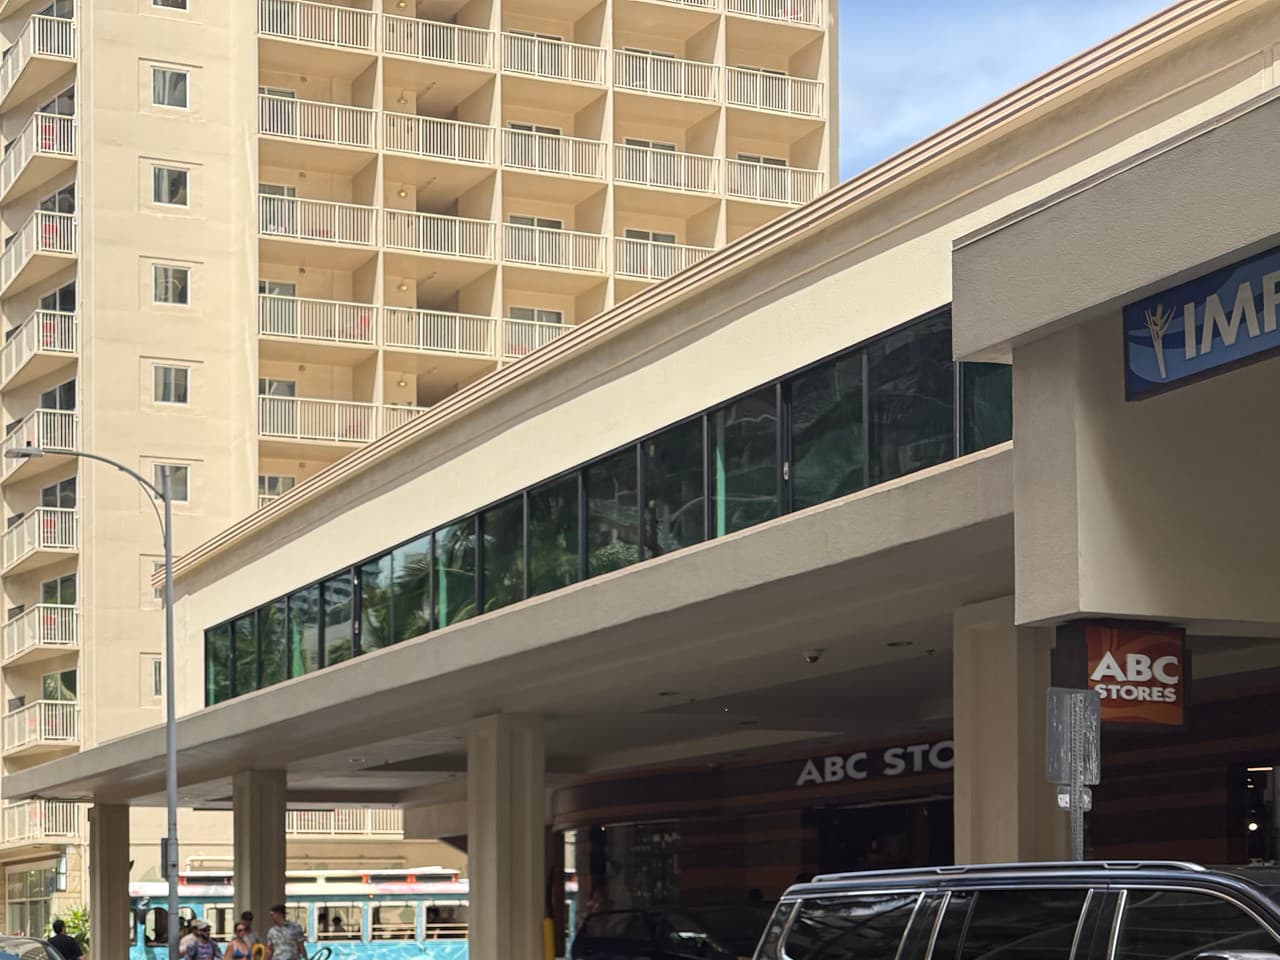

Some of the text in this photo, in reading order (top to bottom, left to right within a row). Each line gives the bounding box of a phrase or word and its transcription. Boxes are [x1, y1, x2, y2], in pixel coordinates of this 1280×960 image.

[1090, 650, 1179, 685] ABC
[1093, 683, 1177, 703] STORES
[795, 751, 868, 787] ABC
